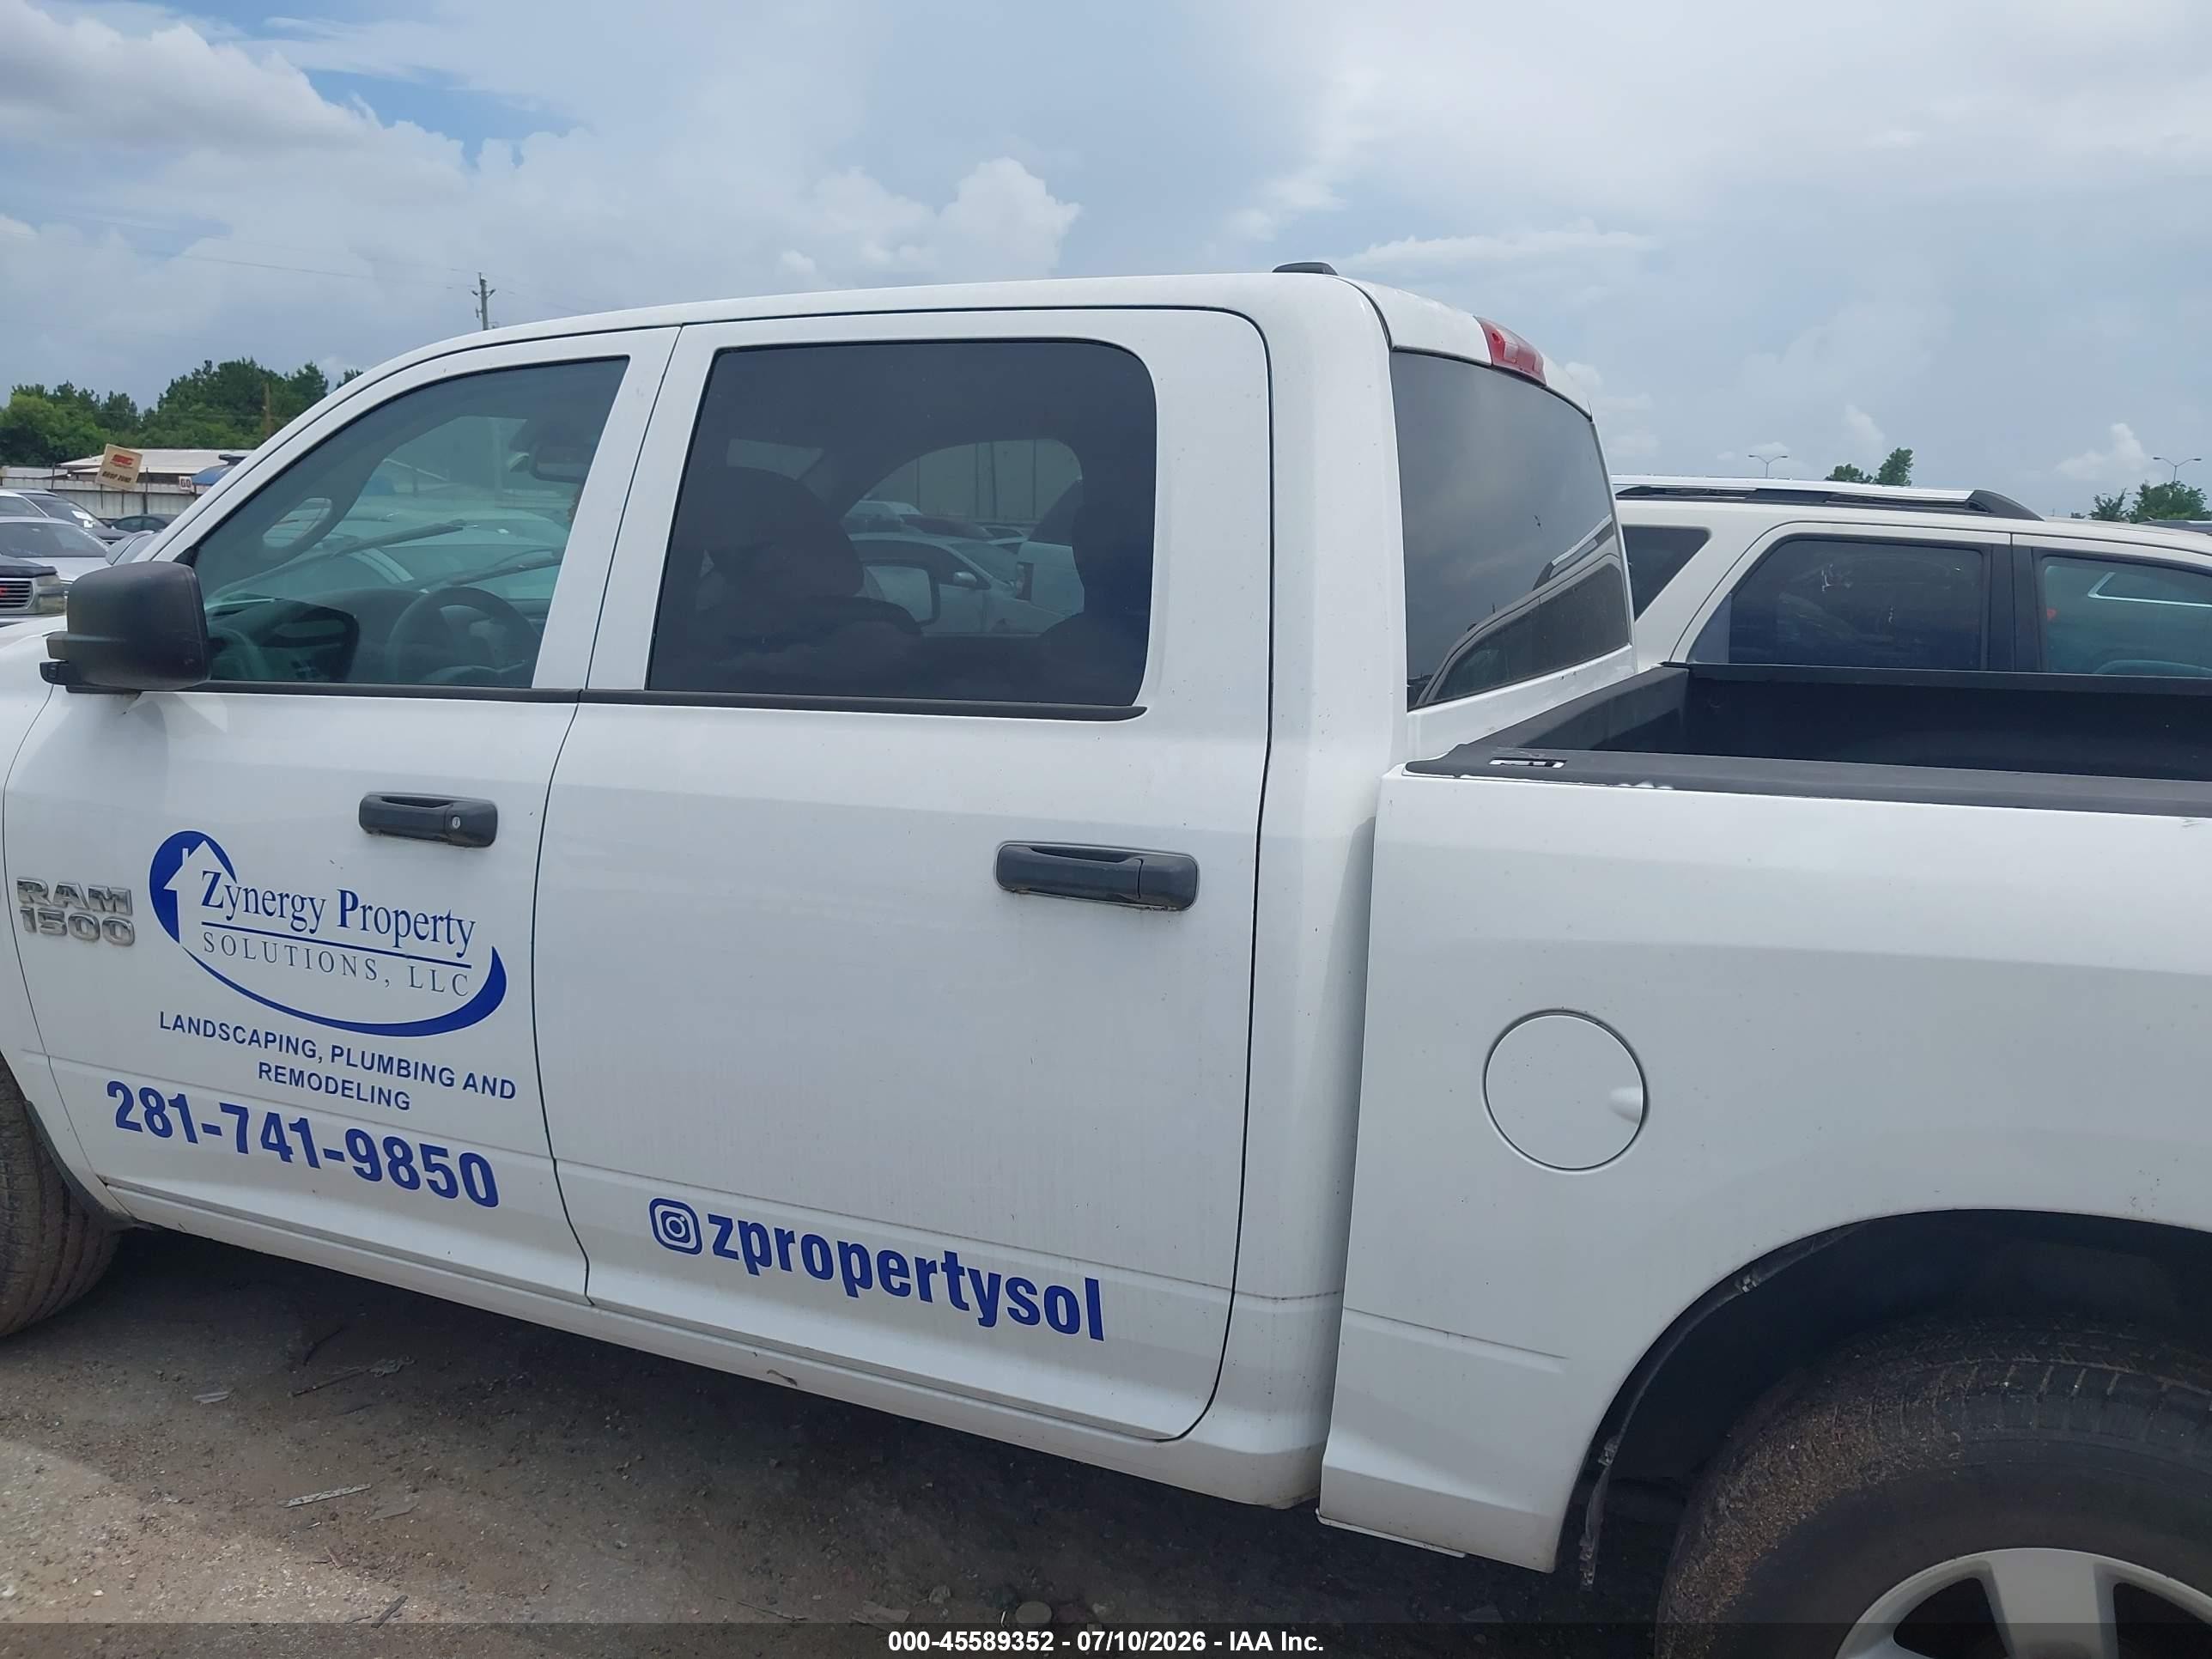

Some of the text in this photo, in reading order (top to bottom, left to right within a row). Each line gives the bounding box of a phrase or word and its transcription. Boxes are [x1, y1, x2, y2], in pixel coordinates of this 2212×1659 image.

[16, 877, 133, 915] RAM
[20, 906, 136, 946] 1500
[201, 870, 477, 958] Zynergy Property
[203, 931, 469, 997] SOLUTIONS, LLC
[160, 1011, 516, 1100] LANDSCAPING, PLUMBING AND
[258, 1060, 411, 1111] REMODELING
[106, 1080, 500, 1208] 281-741-9850
[708, 1212, 1105, 1342] zpropertysol
